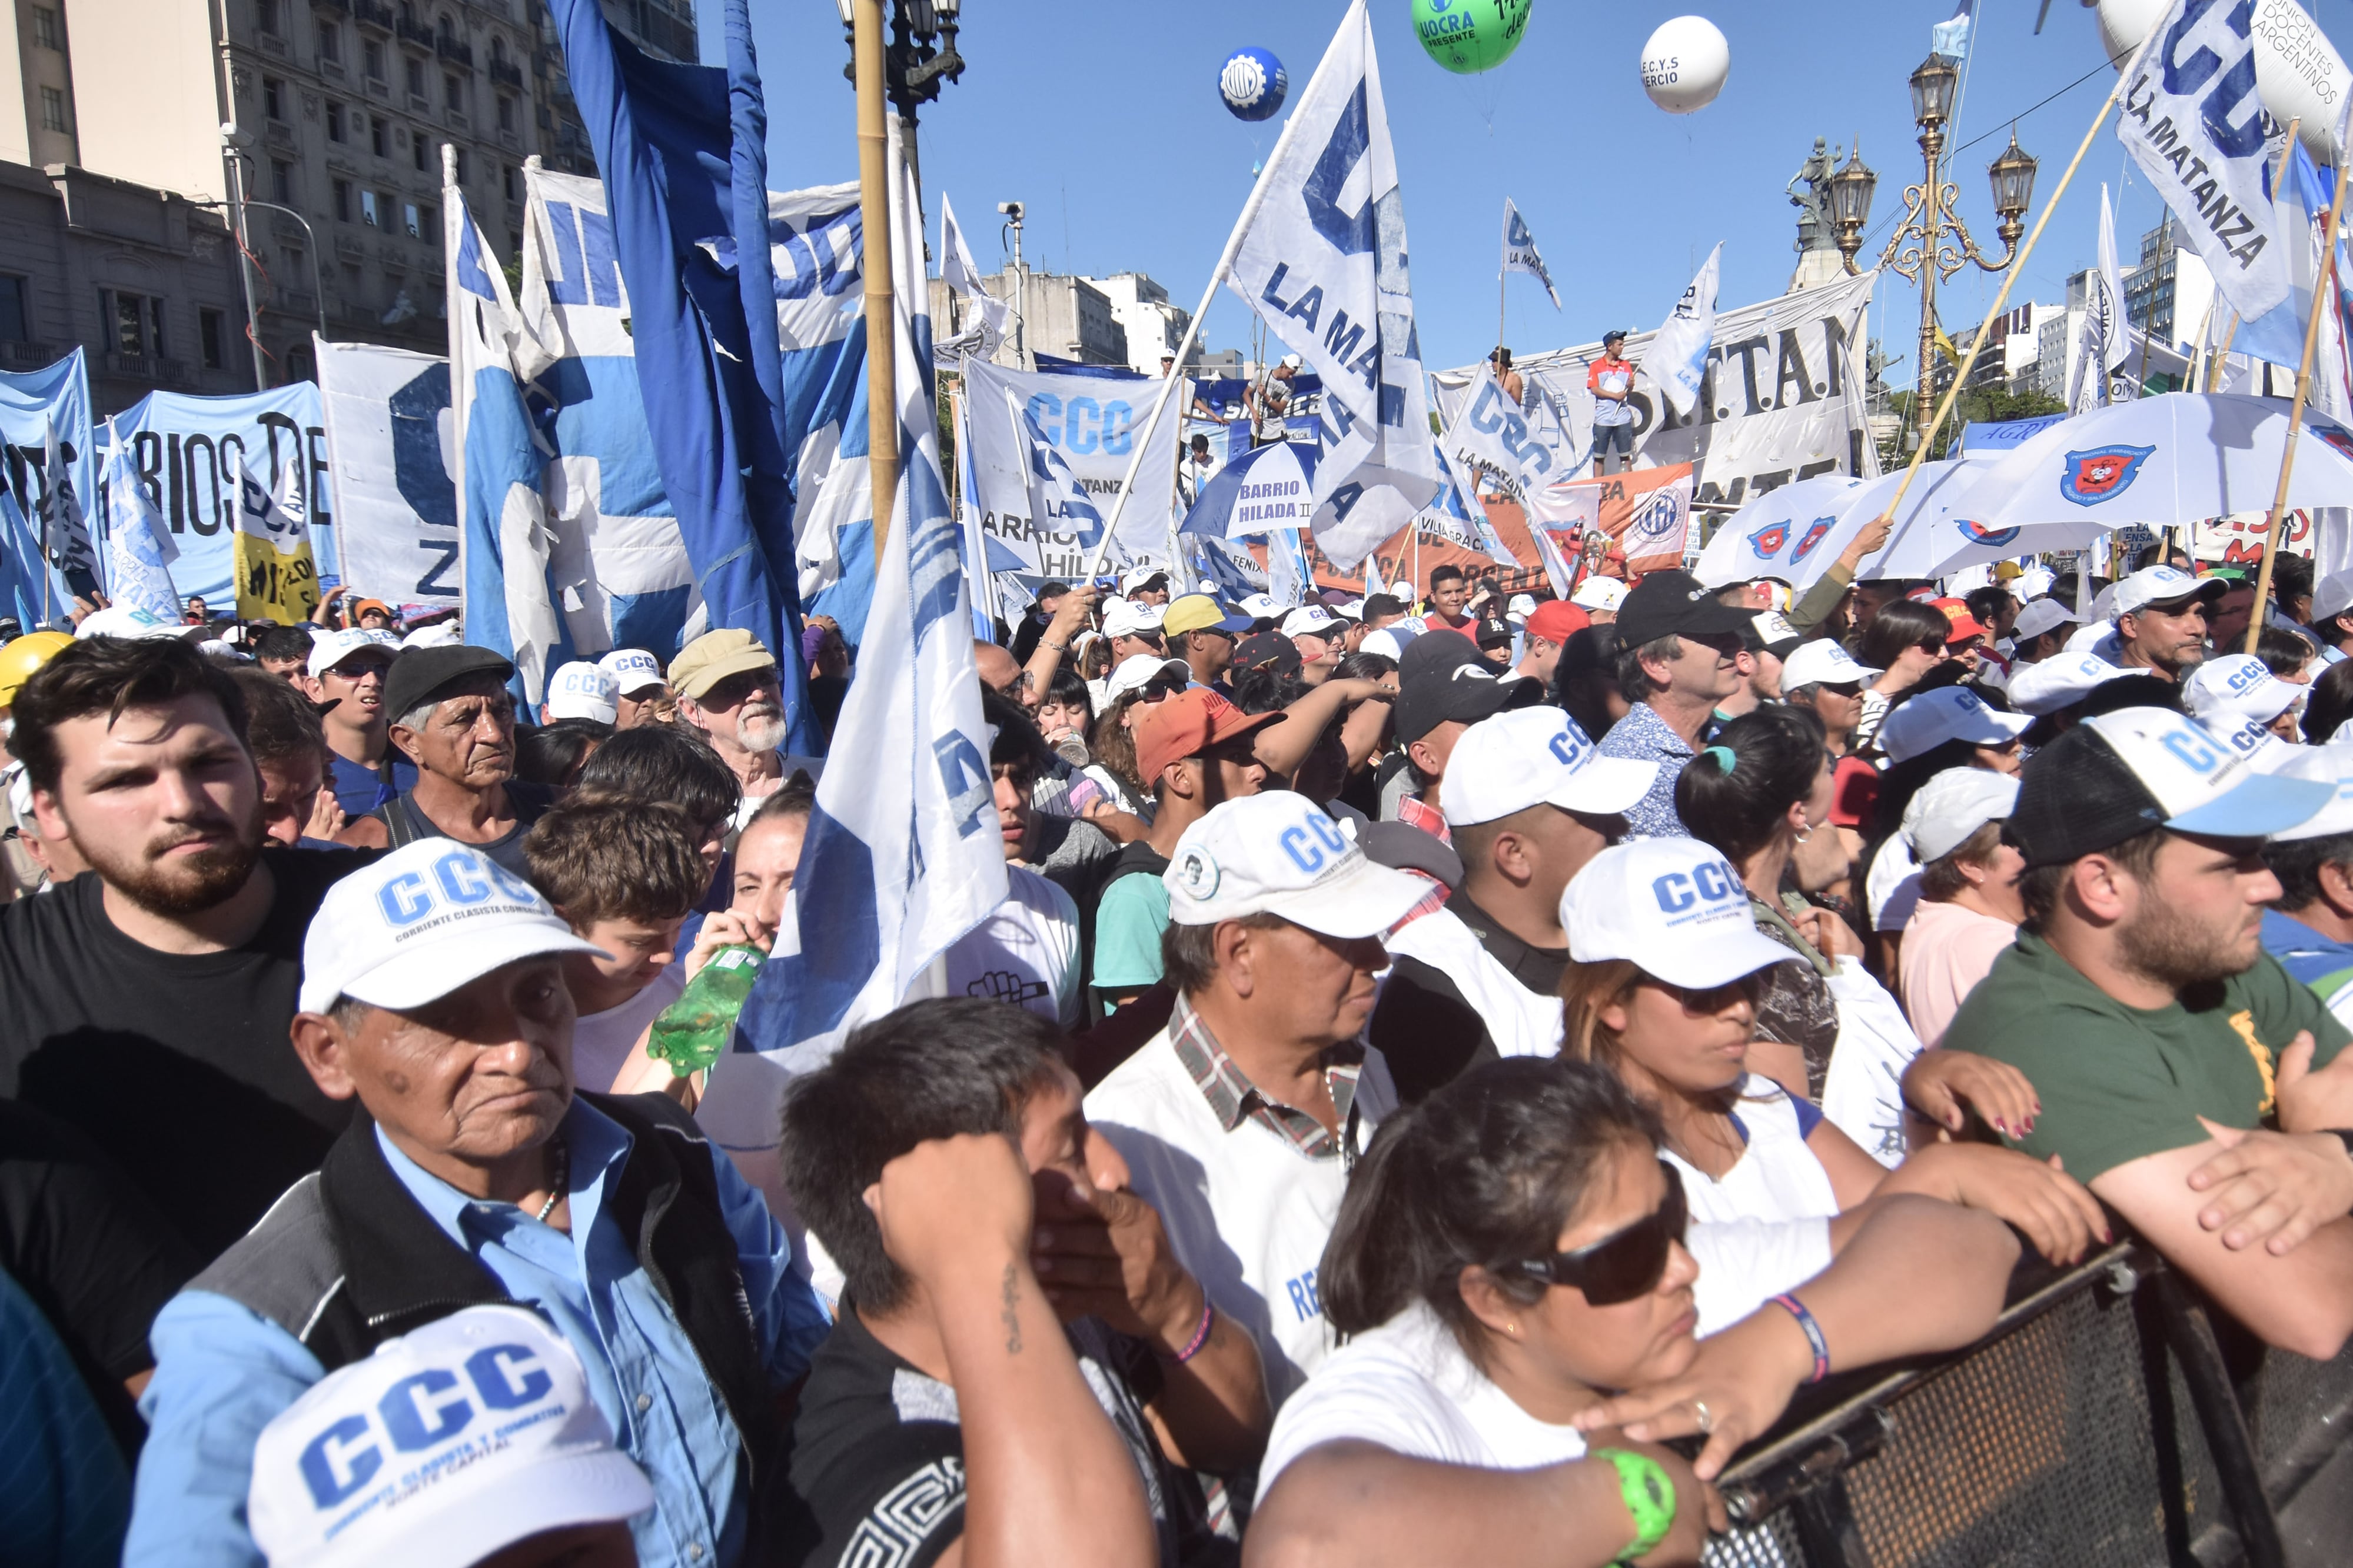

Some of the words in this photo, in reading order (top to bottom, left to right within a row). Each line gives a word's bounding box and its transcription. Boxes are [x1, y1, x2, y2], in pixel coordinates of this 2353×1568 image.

[1420, 11, 1475, 39] UOCRA
[1428, 29, 1476, 48] PRESENTE
[2263, 5, 2334, 75] DOCENTES
[2252, 21, 2337, 104] ARGENTINOS
[2126, 74, 2156, 127] LA
[2146, 116, 2268, 271] MATANZA
[1510, 252, 1518, 264] LA
[1261, 262, 1324, 334] LA
[1455, 447, 1476, 467] LA
[2071, 449, 2107, 460] PERSONAL
[1239, 480, 1300, 501] BARRIO
[1239, 501, 1296, 523] HILADA
[1233, 554, 1262, 574] FENIX
[1491, 618, 1504, 632] LA
[616, 655, 654, 671] CCC
[2227, 661, 2268, 690] CCC
[565, 674, 610, 697] CCC
[375, 853, 539, 928] CCC
[1652, 861, 1744, 914] CCC
[395, 914, 452, 943] CORRIENTE
[453, 905, 501, 921] CLASISTA
[299, 1344, 553, 1512] CCC
[446, 1437, 511, 1476] CAPITAL
